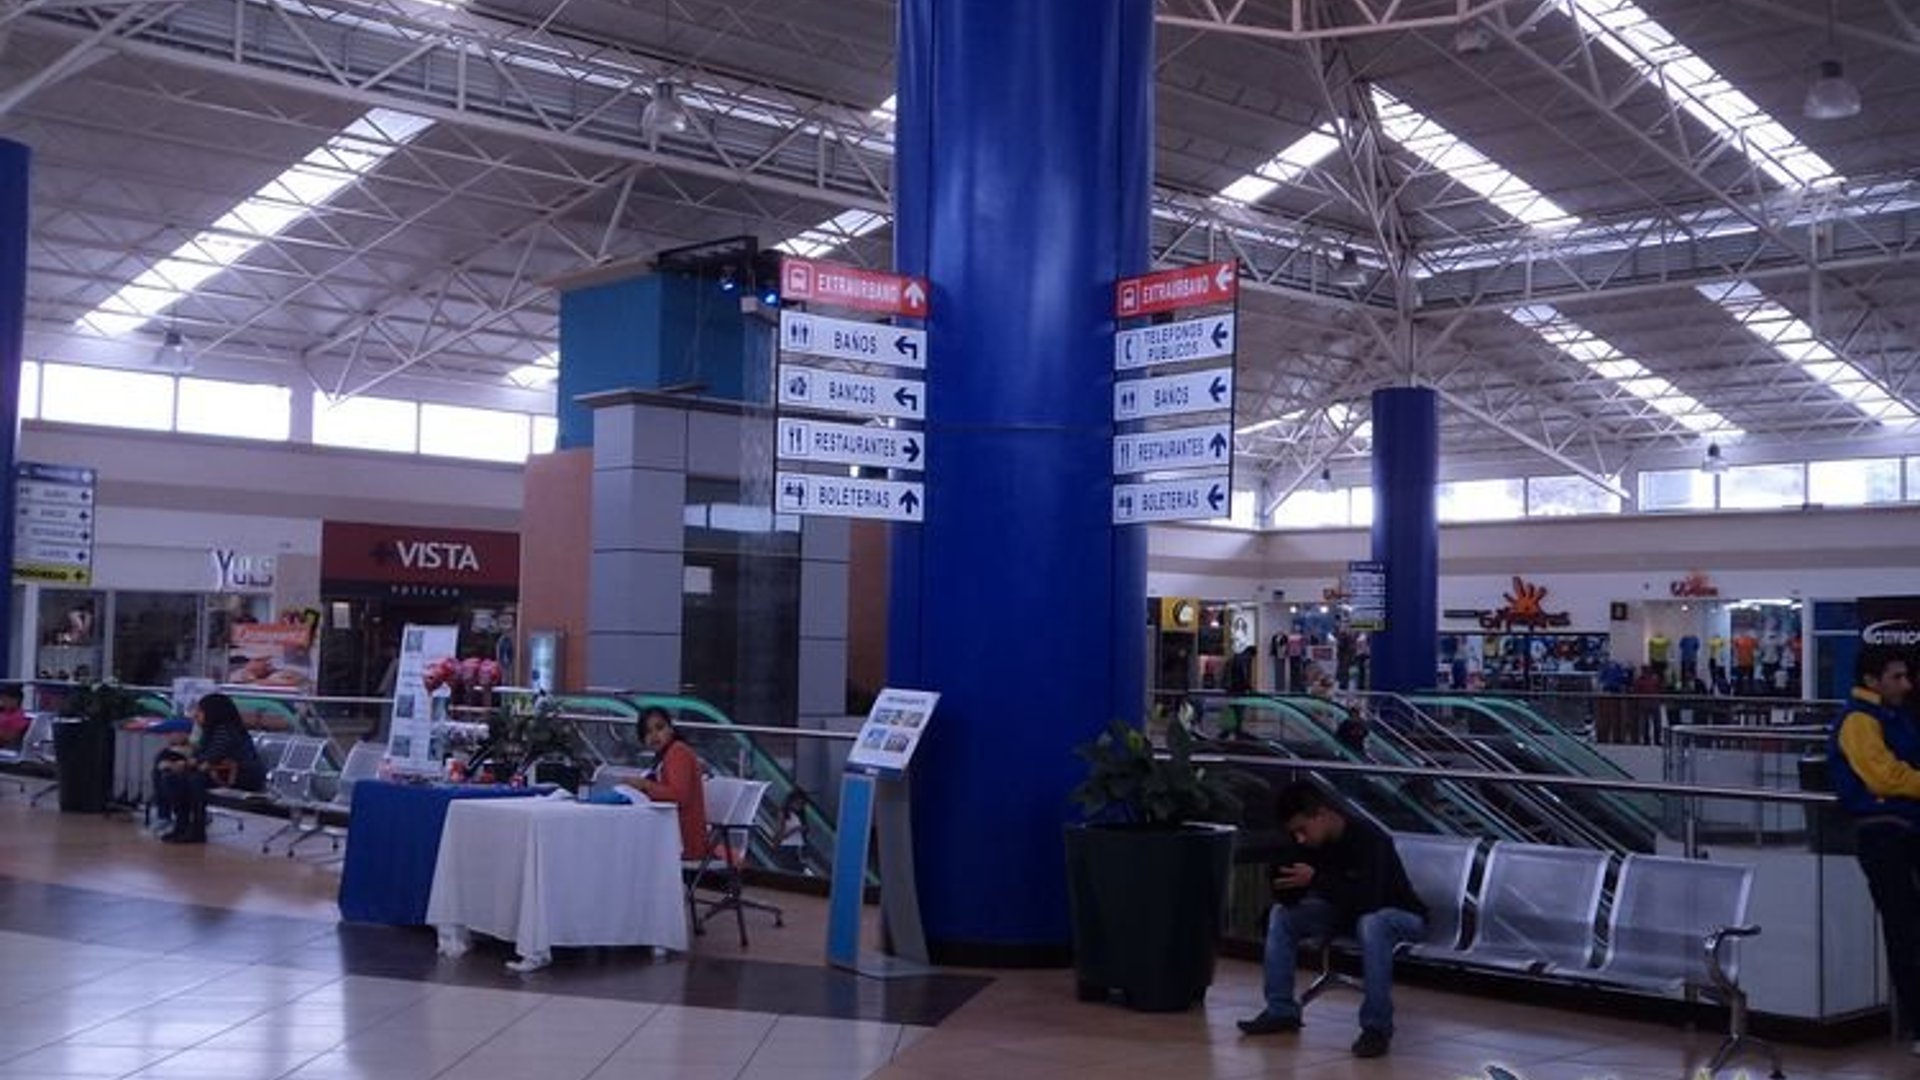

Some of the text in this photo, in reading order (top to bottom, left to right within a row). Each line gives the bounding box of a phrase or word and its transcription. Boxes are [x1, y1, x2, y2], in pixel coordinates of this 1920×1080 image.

[818, 273, 900, 304] EXTRAURBANO
[1142, 275, 1209, 304] EXTRAURBANO
[834, 330, 877, 355] BAÑOS
[1144, 323, 1204, 345] TELEFONOS
[829, 381, 876, 404] BANCOS
[1153, 384, 1189, 408] BAÑOS
[814, 432, 897, 457] RESTAURANTES
[1138, 437, 1205, 463] RESTAURANTES
[818, 486, 890, 508] BOLETERIAS
[1141, 489, 1199, 511] BOLETERIAS
[396, 540, 480, 571] VISTA
